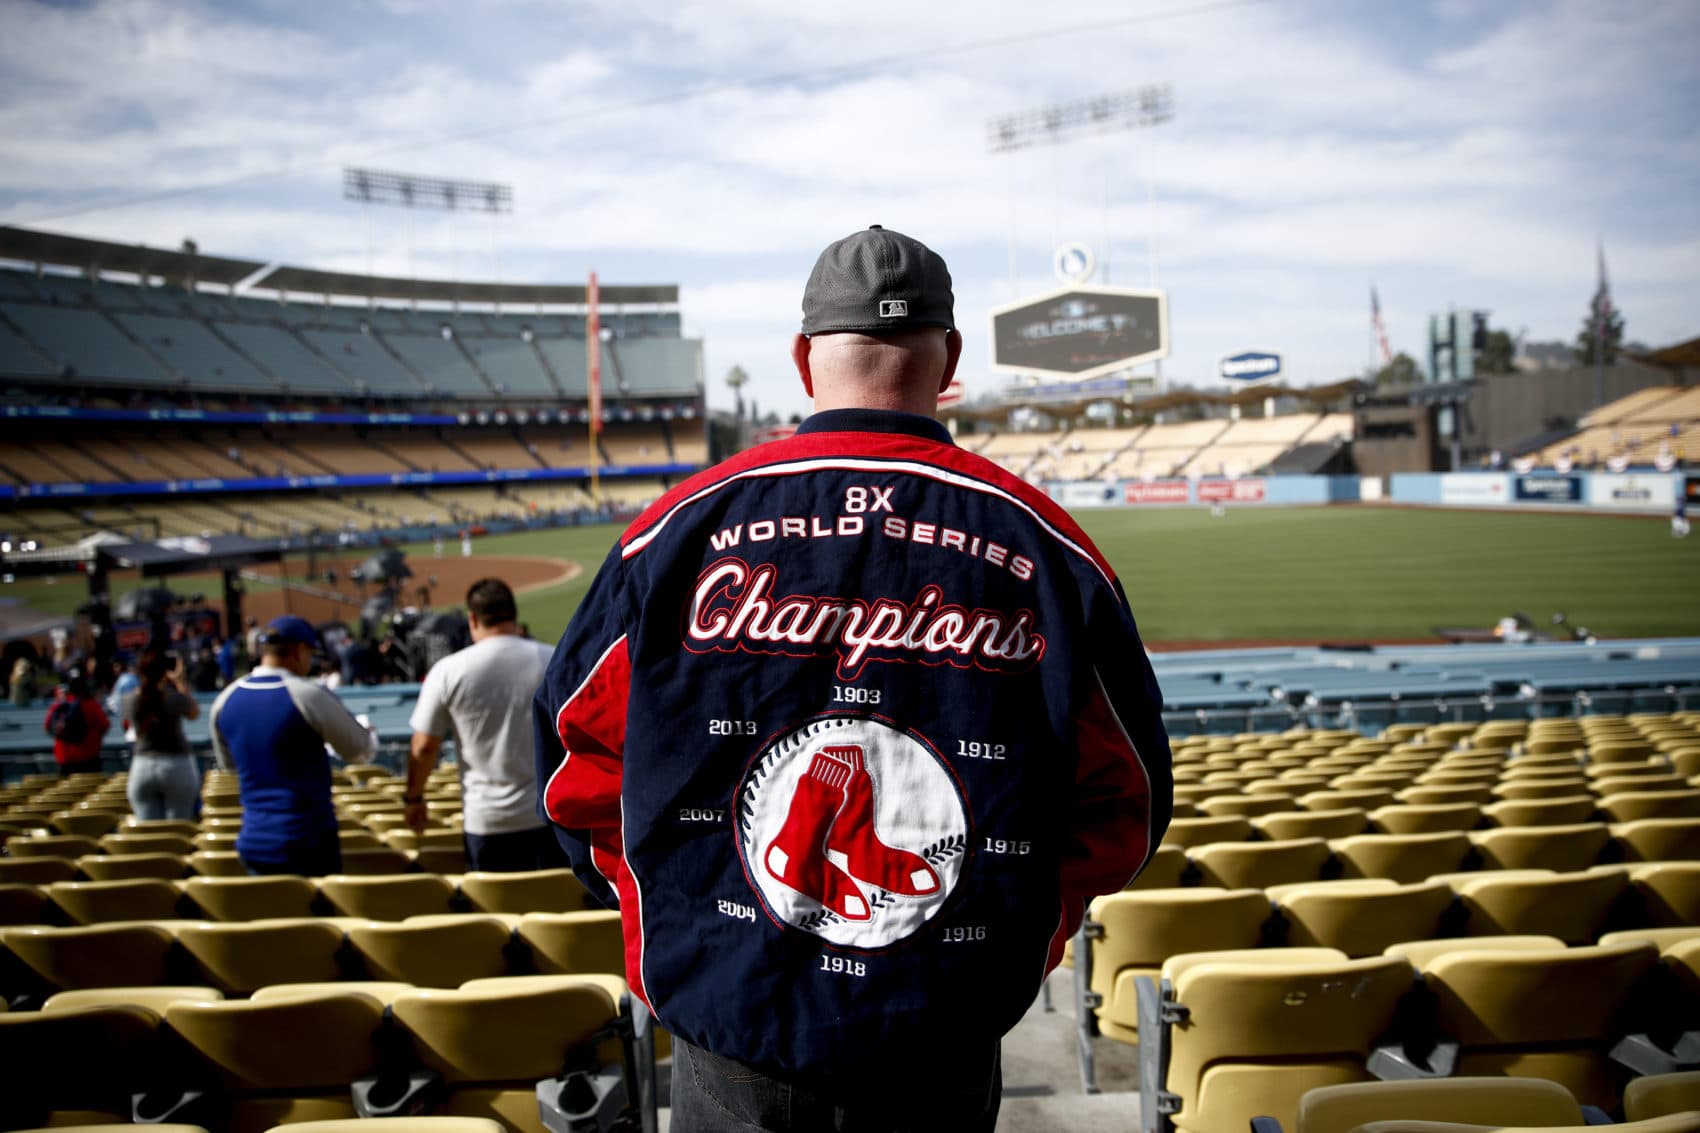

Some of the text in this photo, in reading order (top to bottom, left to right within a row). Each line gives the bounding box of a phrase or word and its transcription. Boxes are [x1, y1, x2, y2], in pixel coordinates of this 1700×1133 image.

[845, 486, 895, 513] 8X
[710, 516, 1034, 580] WORLD SERIES
[684, 557, 1046, 679] Champions
[833, 686, 881, 704] 1903
[709, 720, 757, 735] 2013
[957, 740, 1005, 759] 1912
[680, 809, 725, 822] 2007
[984, 838, 1030, 855] 1915
[718, 900, 756, 922] 2004
[943, 926, 986, 942] 1916
[820, 955, 866, 976] 1918
